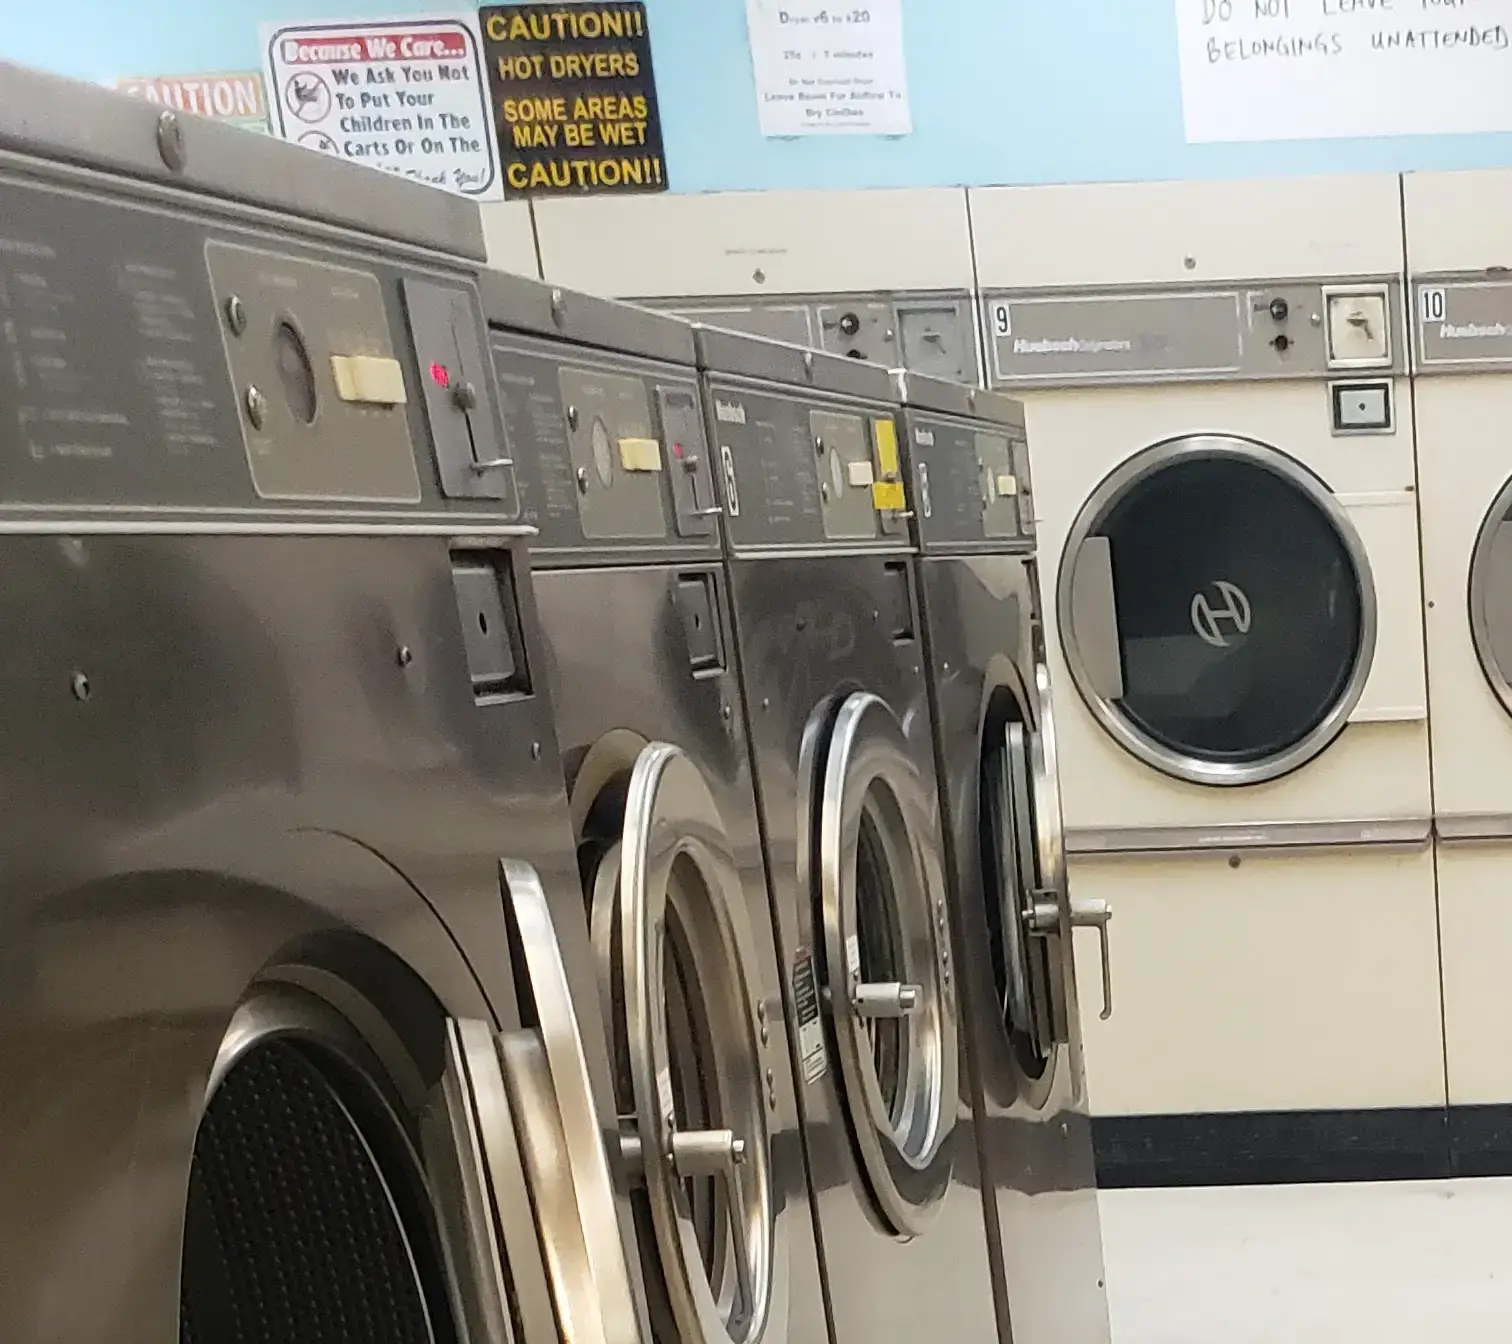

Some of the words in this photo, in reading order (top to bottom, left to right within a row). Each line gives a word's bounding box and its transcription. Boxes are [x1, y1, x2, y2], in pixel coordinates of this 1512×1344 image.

[486, 10, 644, 41] CAUTION!!
[1202, 0, 1232, 25] DO
[284, 41, 361, 62] Because
[366, 38, 396, 59] We
[401, 36, 465, 57] Care...
[1207, 33, 1343, 63] BELONGINGS
[1372, 25, 1510, 51] UNATTENDED
[332, 68, 359, 86] We
[366, 67, 395, 84] Ask
[402, 66, 433, 83] You
[438, 64, 469, 81] Not
[499, 54, 545, 81] HOT
[550, 52, 640, 79] DRYERS
[336, 94, 354, 111] To
[360, 92, 390, 109] Put
[396, 91, 434, 107] Your
[504, 98, 568, 122] SOME
[573, 95, 648, 120] AREAS
[340, 116, 412, 133] Children
[417, 115, 434, 131] In
[439, 113, 471, 130] The
[513, 125, 559, 148] MAY
[564, 123, 596, 146] BE
[599, 121, 648, 146] WET
[343, 139, 389, 157] Carts
[395, 138, 415, 155] Or
[421, 137, 444, 154] On
[449, 137, 480, 153] The
[507, 158, 662, 189] CAUTION!!
[1422, 291, 1443, 319] 10
[996, 306, 1009, 332] 9
